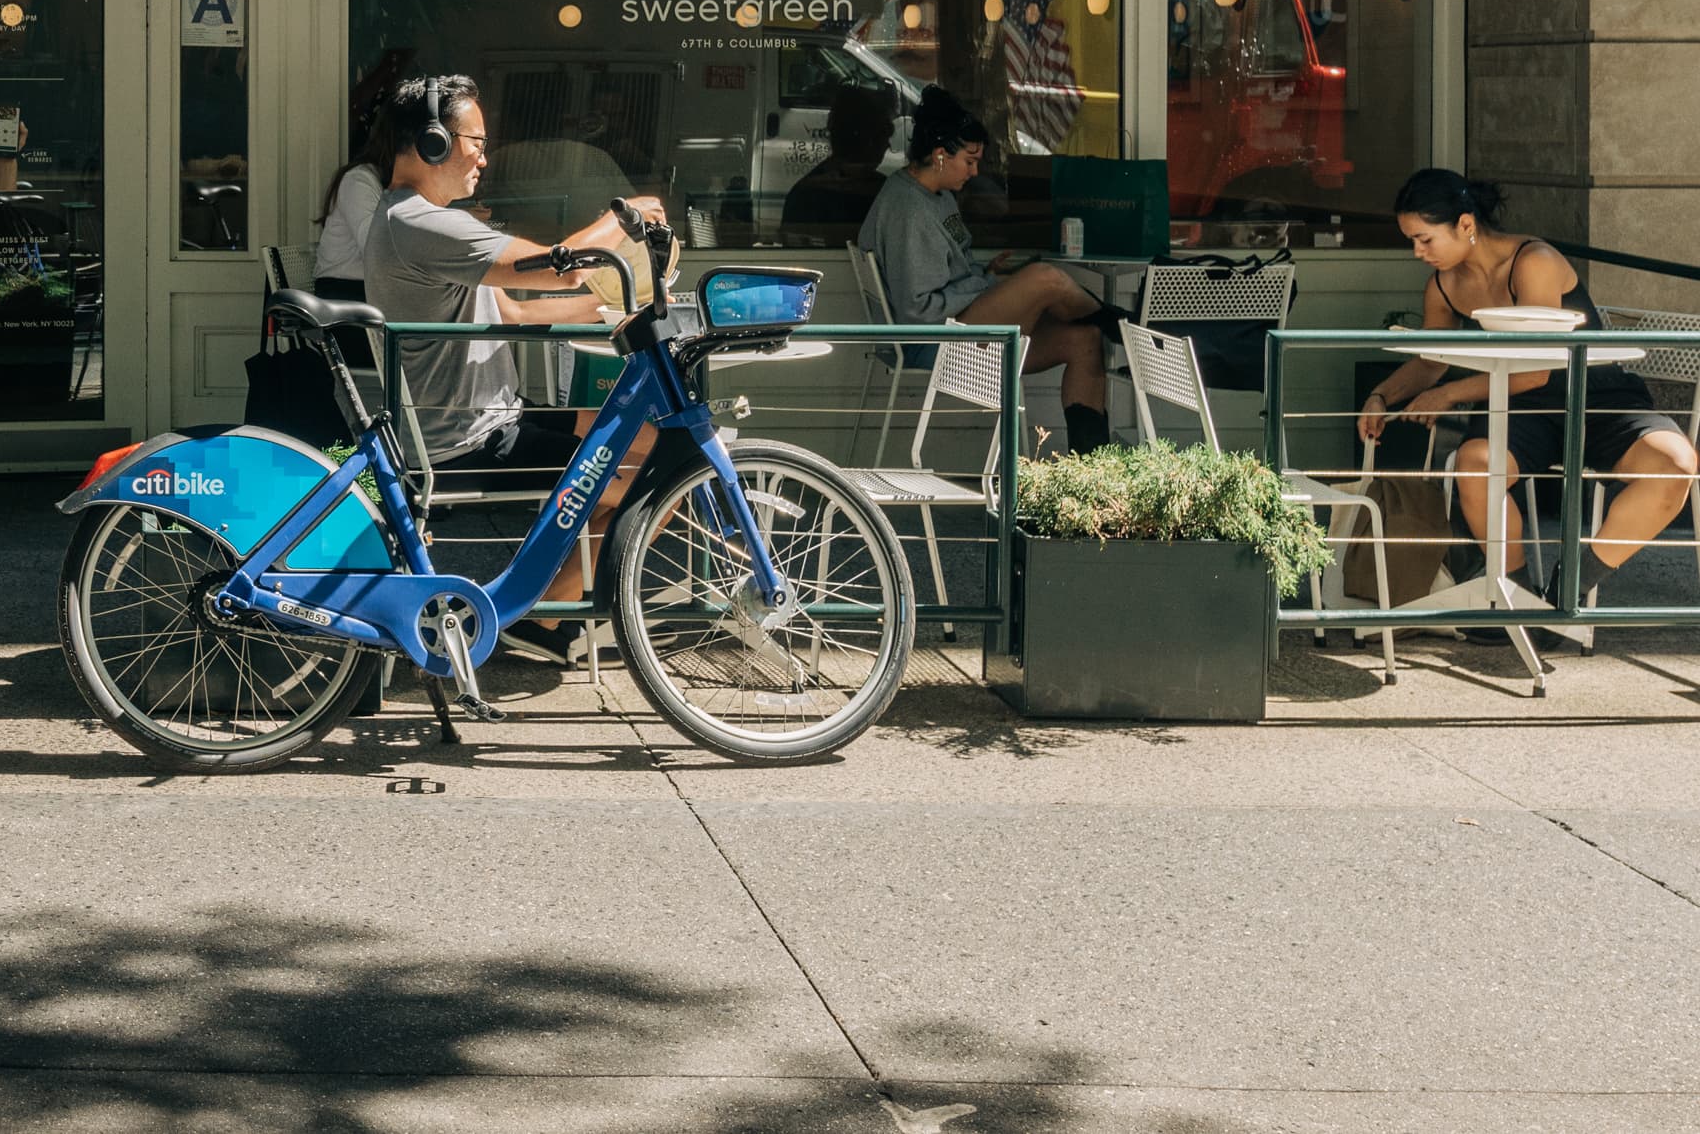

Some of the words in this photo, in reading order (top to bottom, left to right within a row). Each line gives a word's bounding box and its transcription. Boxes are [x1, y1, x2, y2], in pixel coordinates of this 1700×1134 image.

[681, 38, 711, 49] 67TH
[729, 38, 797, 49] COLUMBUS
[132, 469, 171, 495] citi
[174, 472, 225, 495] bike
[571, 445, 613, 495] bike
[557, 486, 587, 529] citi
[282, 603, 328, 624] 626-1853
